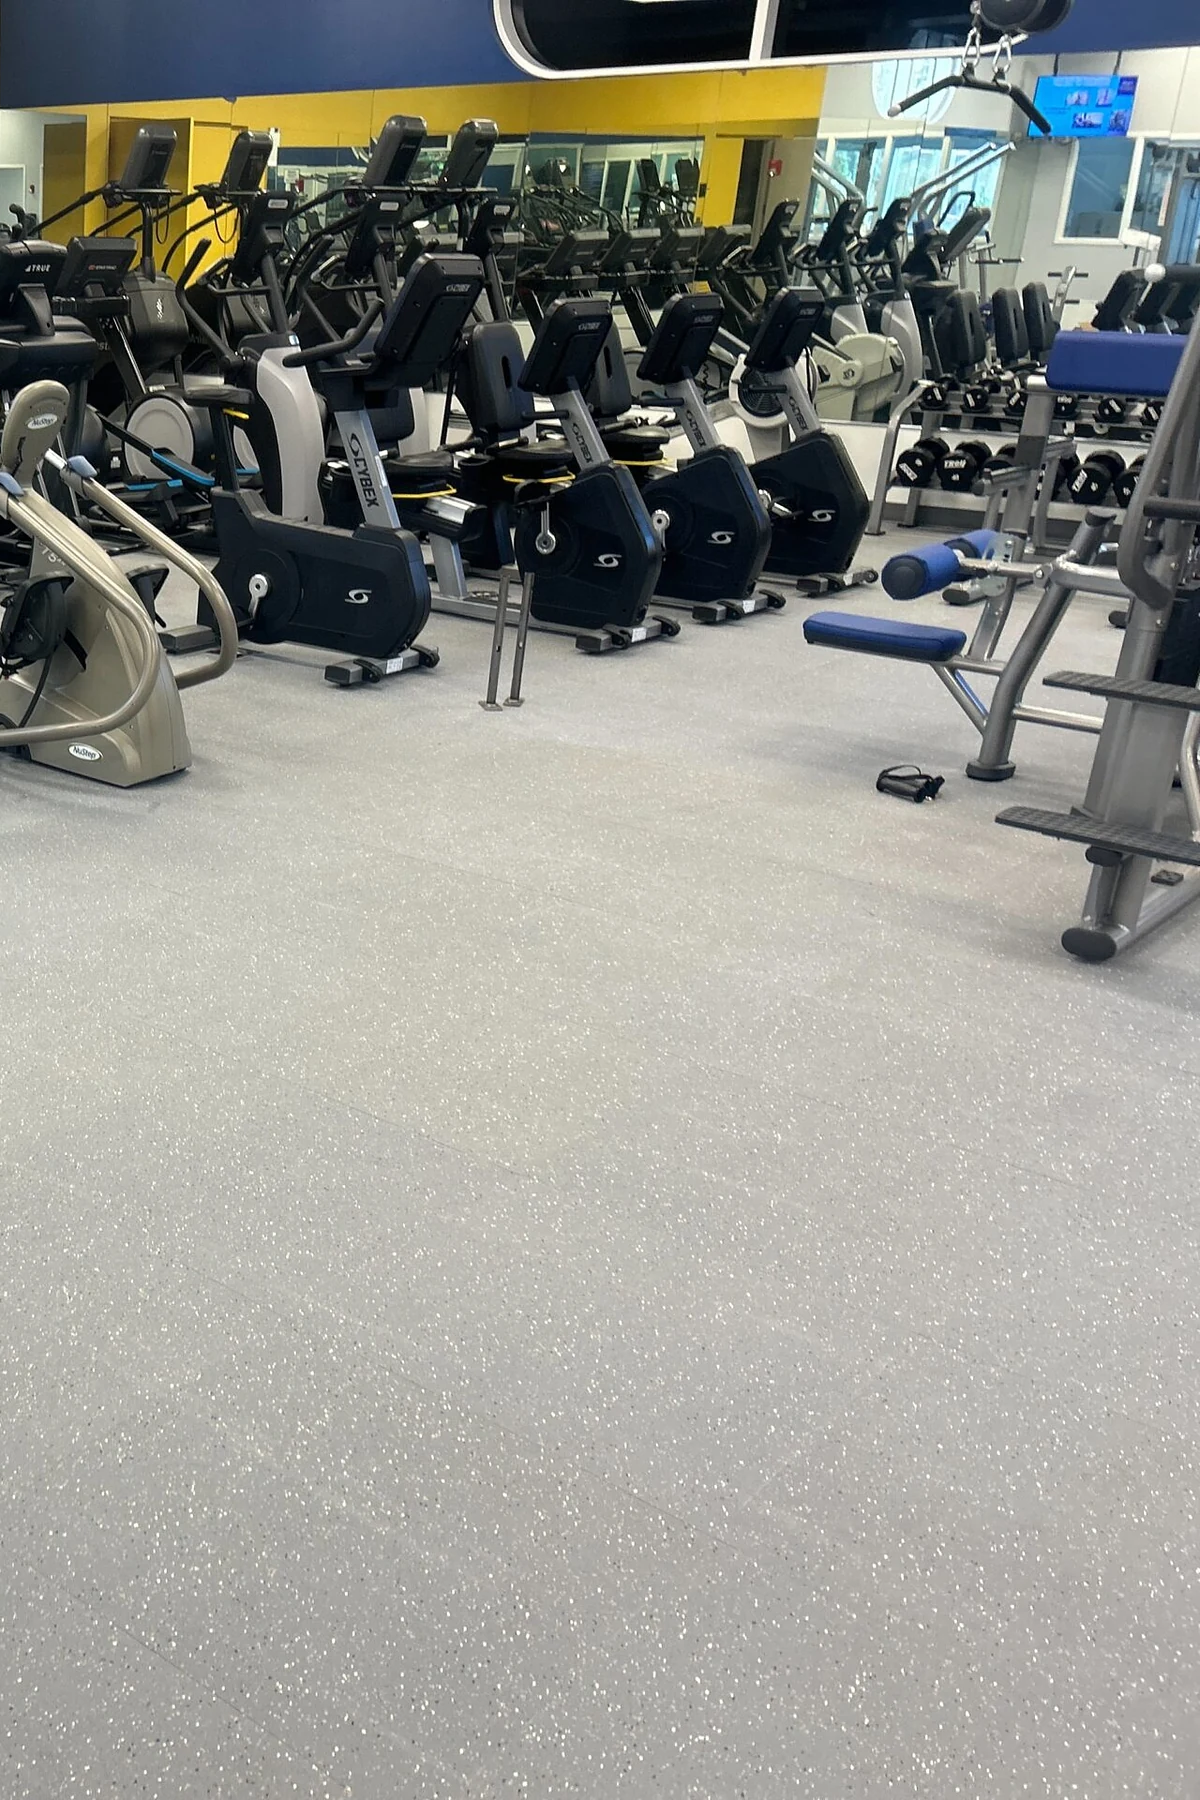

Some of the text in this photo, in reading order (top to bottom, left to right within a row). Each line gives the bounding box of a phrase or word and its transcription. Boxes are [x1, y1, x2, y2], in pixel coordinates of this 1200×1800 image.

[32, 264, 50, 272] TRUE
[353, 458, 380, 507] CYBEX
[73, 746, 96, 759] NuStep
